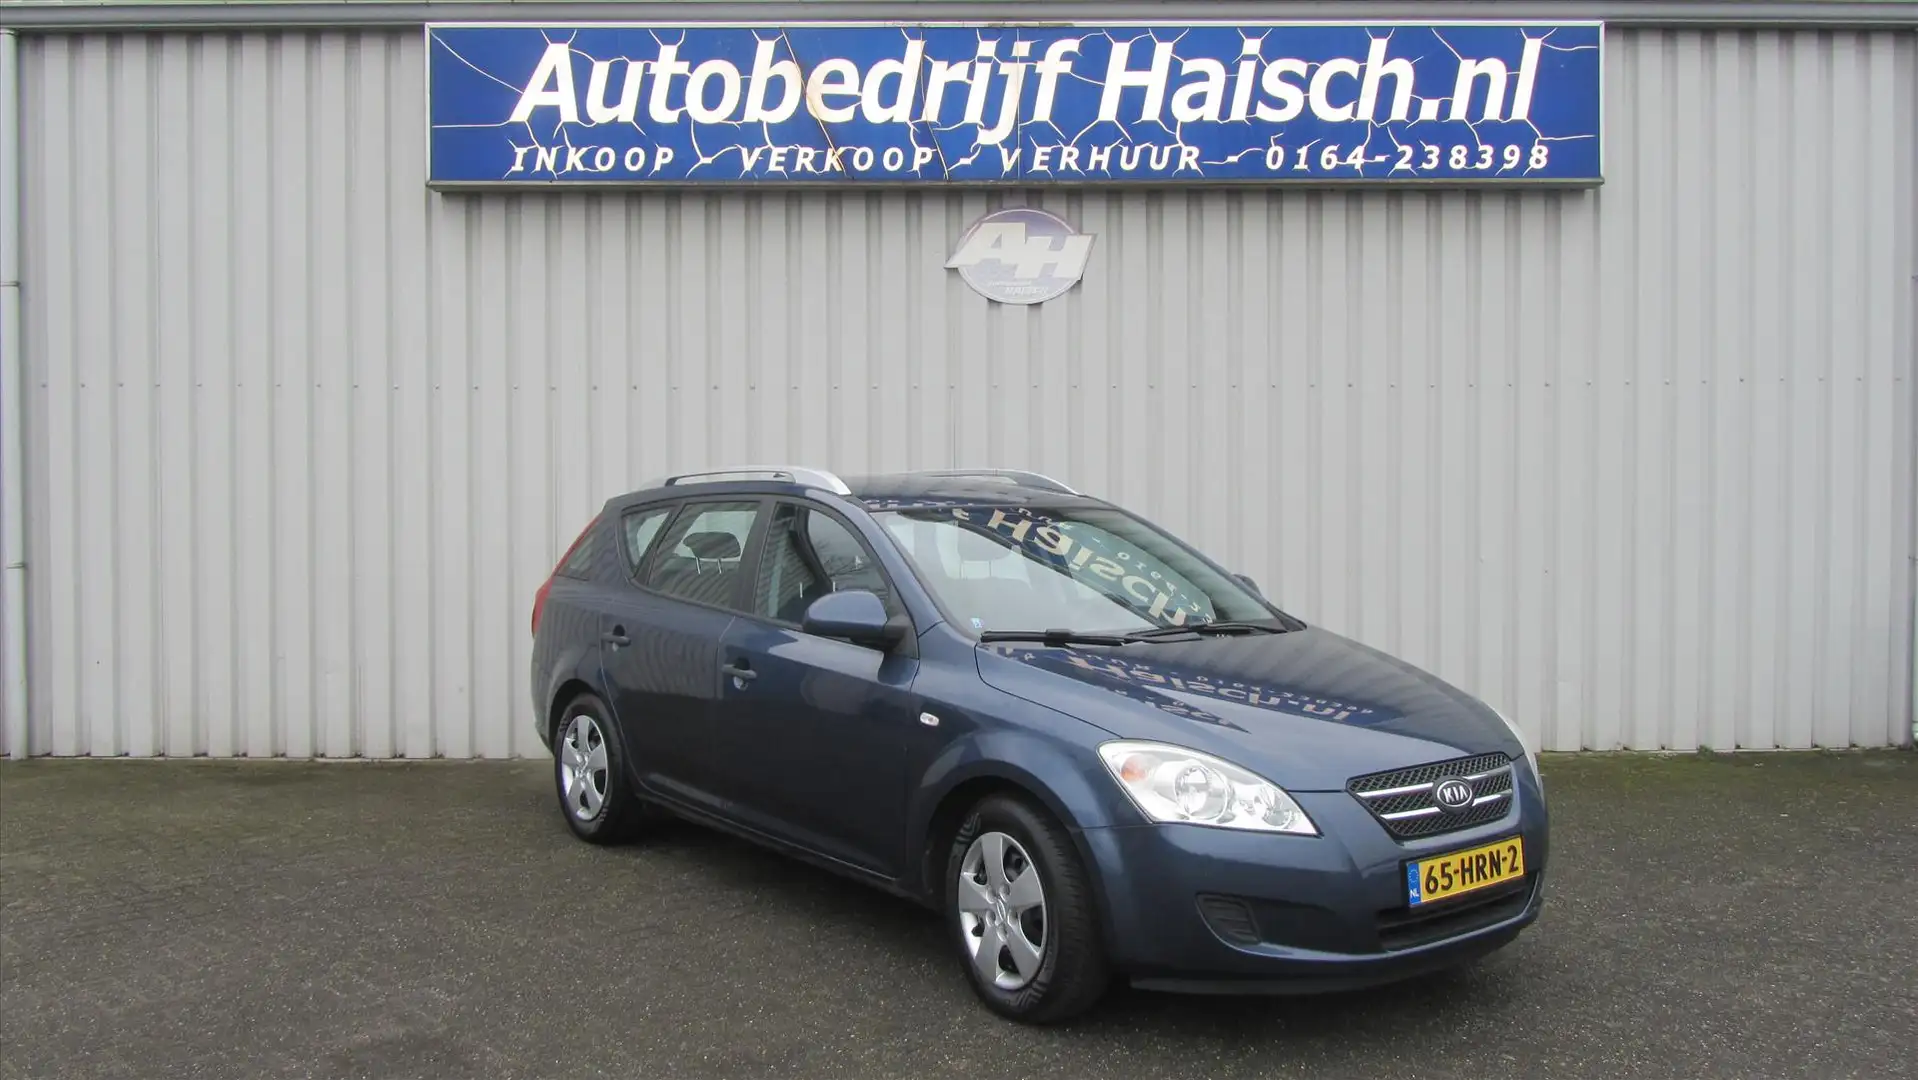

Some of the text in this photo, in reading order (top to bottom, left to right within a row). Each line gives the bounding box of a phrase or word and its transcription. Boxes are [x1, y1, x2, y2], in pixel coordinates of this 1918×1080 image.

[508, 36, 1543, 145] Autobedrijf Haisch.nl
[511, 146, 674, 172] INKOOP
[738, 146, 934, 172] VERKOOP
[1000, 145, 1201, 172] VERHUUR
[1265, 144, 1549, 170] 0164-238398
[1442, 785, 1469, 804] KIA
[1424, 844, 1520, 895] 65-HRN-2
[1410, 888, 1420, 898] NL
